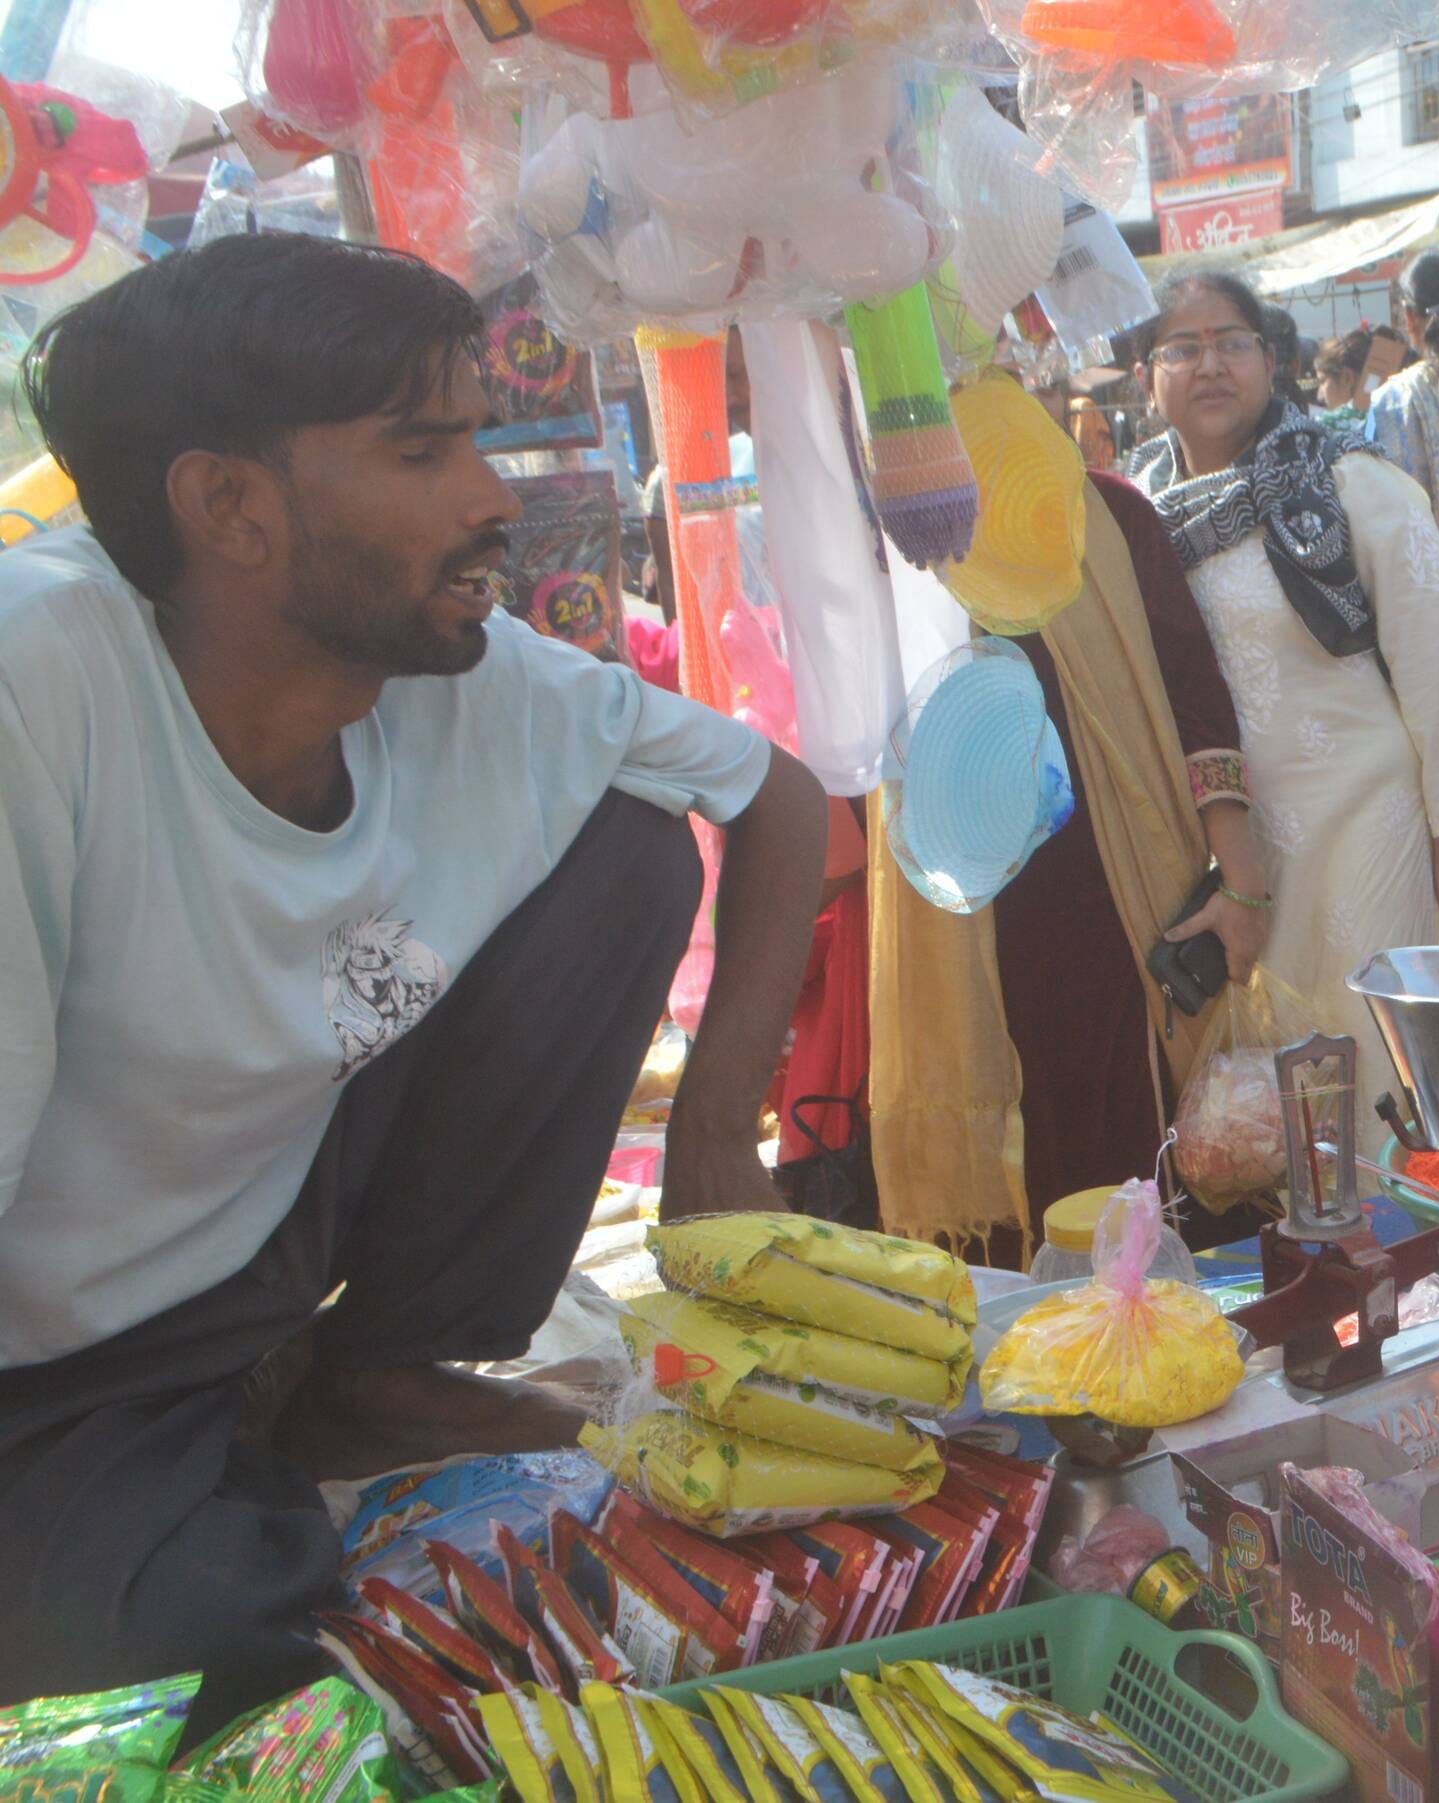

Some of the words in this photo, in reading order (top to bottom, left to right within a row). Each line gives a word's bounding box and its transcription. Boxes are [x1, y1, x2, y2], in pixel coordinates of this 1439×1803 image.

[1236, 1546, 1258, 1565] VIP
[1289, 1501, 1373, 1608] TOTA
[1289, 1591, 1315, 1646] Big
[1343, 1589, 1375, 1625] BRAND
